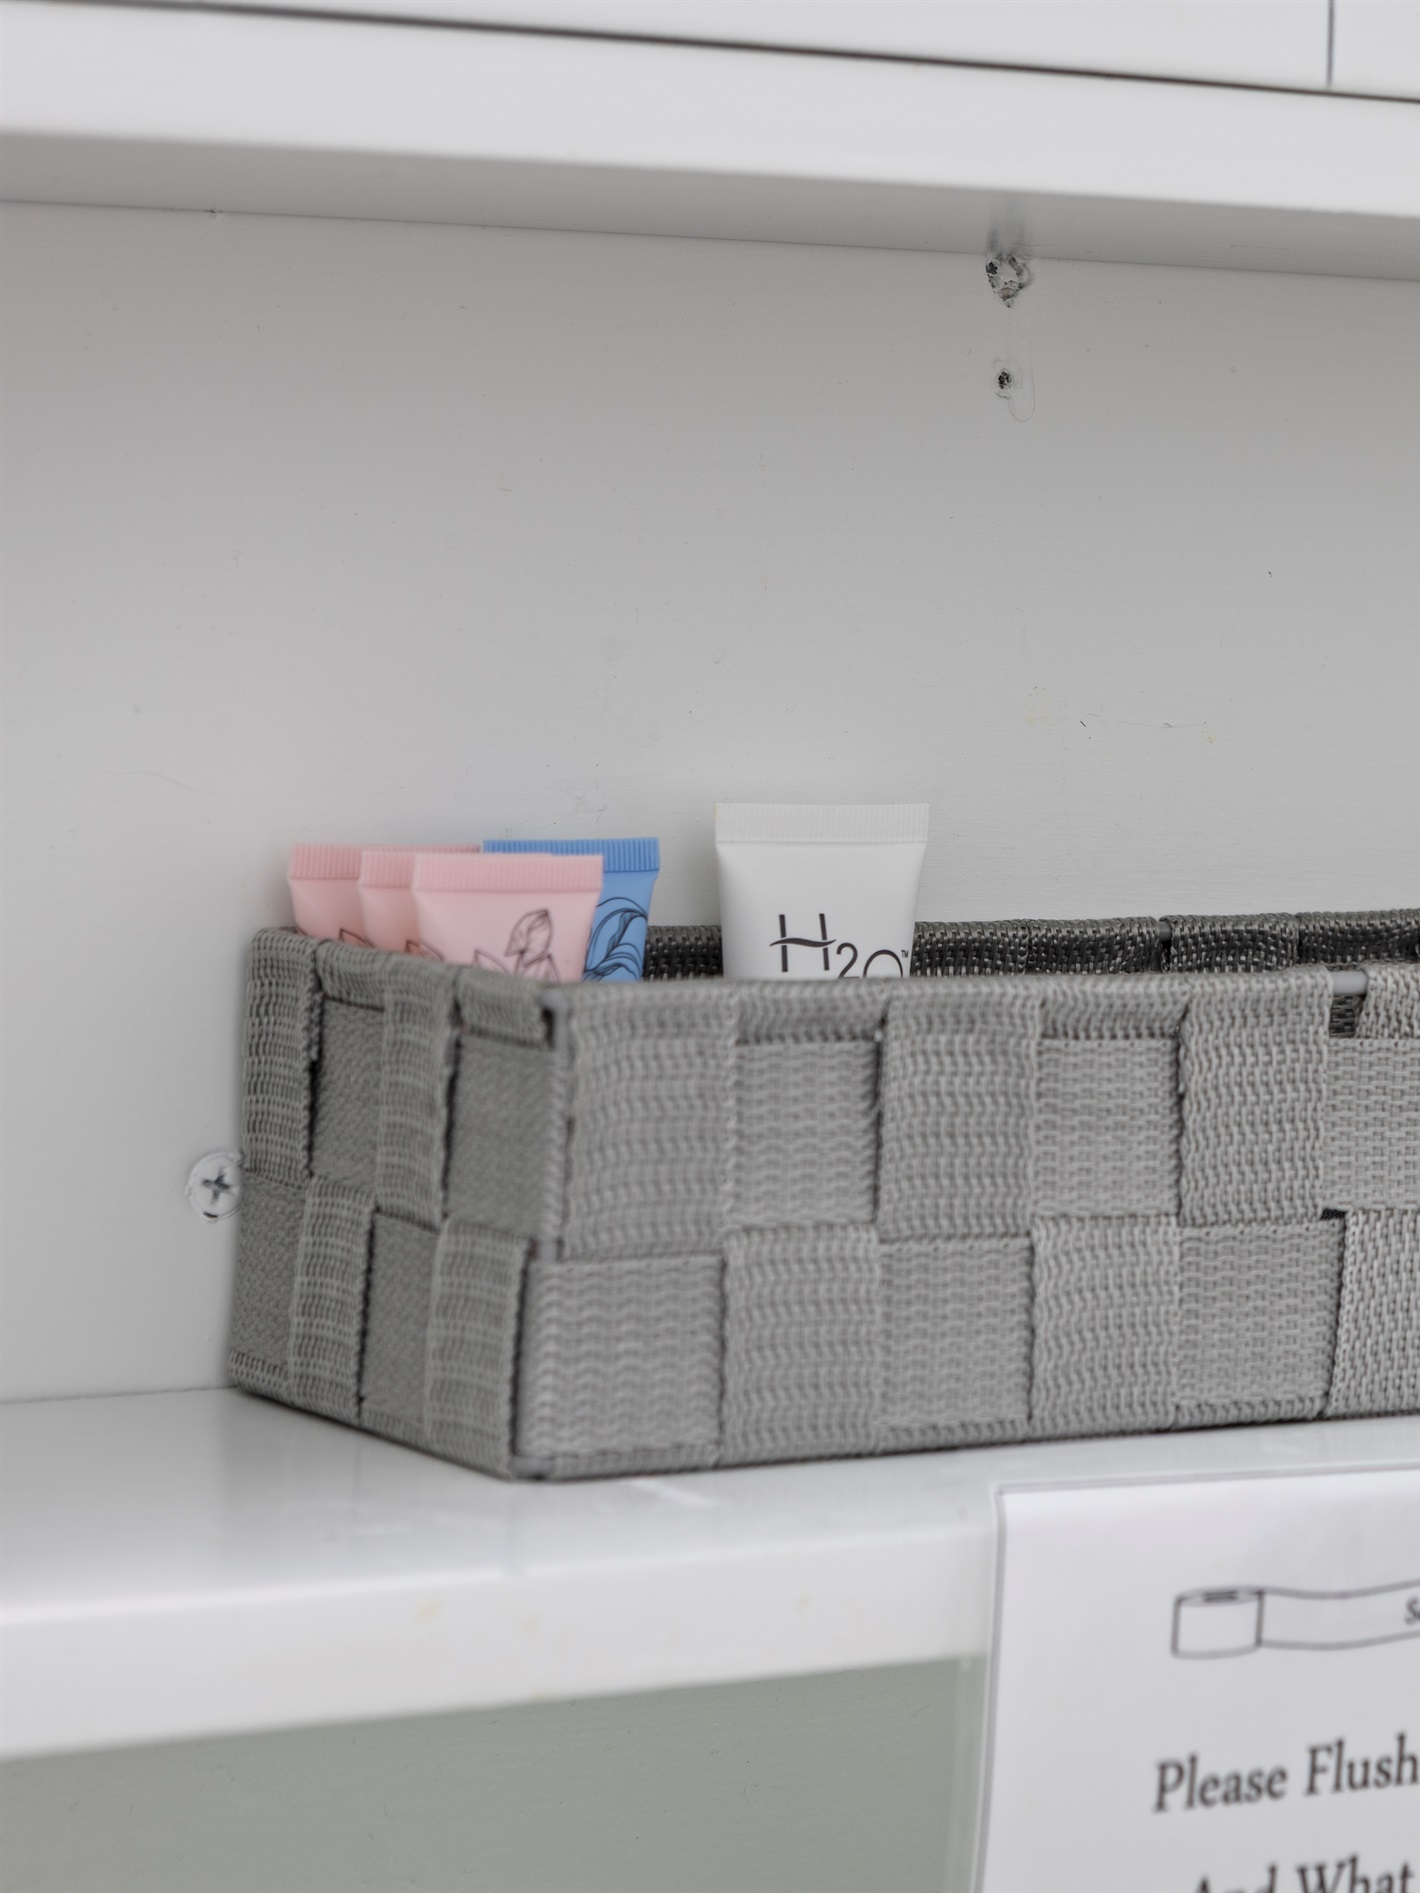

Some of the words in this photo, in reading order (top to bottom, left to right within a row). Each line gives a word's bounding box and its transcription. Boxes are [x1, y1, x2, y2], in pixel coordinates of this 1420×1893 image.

[1153, 1751, 1288, 1813] Please
[1304, 1736, 1420, 1796] Flush
[1296, 1854, 1413, 1893] What
